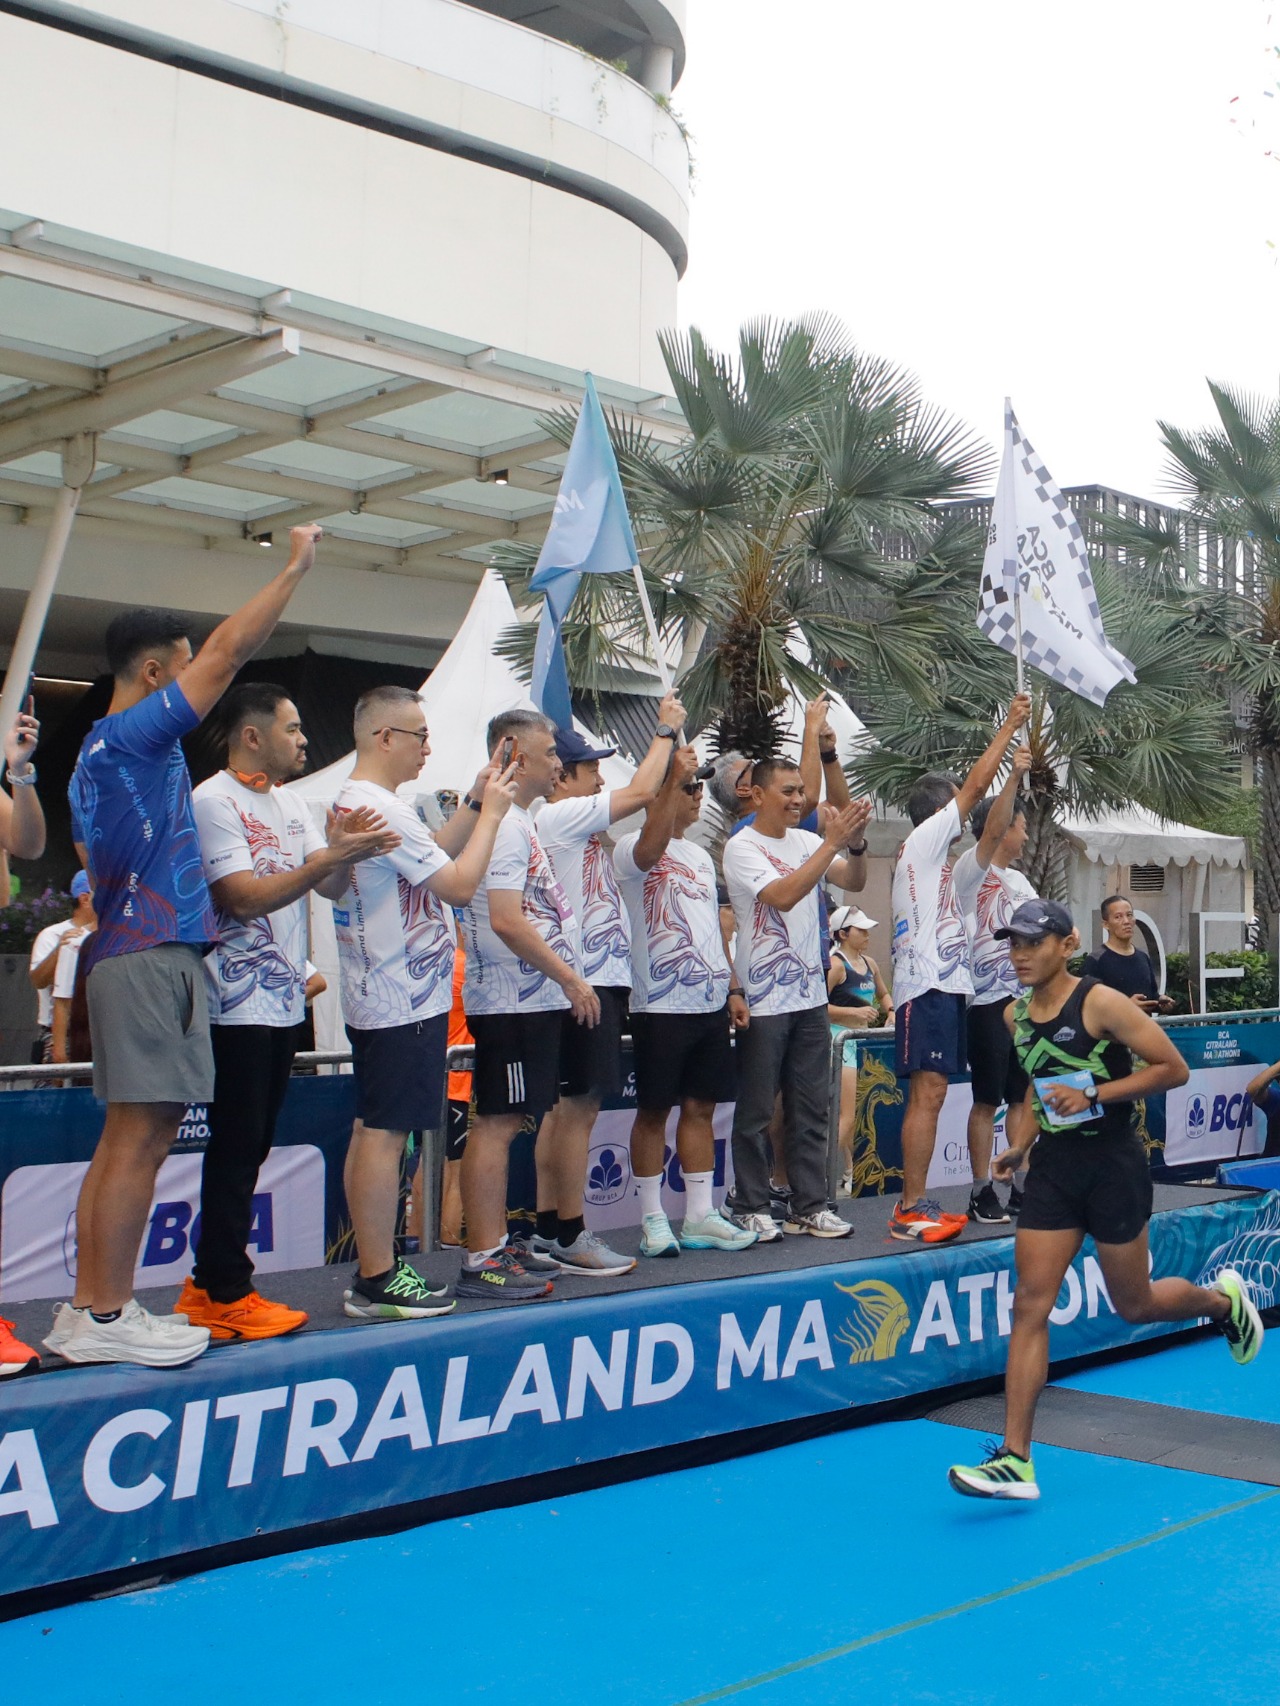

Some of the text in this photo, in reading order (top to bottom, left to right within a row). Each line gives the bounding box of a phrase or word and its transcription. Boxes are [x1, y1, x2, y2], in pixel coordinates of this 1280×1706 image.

[1218, 1031, 1230, 1039] BCA
[1205, 1040, 1237, 1050] CITRALAND
[1210, 1092, 1253, 1132] BCA
[944, 1166, 957, 1176] The
[480, 1270, 506, 1286] HOKA
[83, 1322, 695, 1514] CITRALAND
